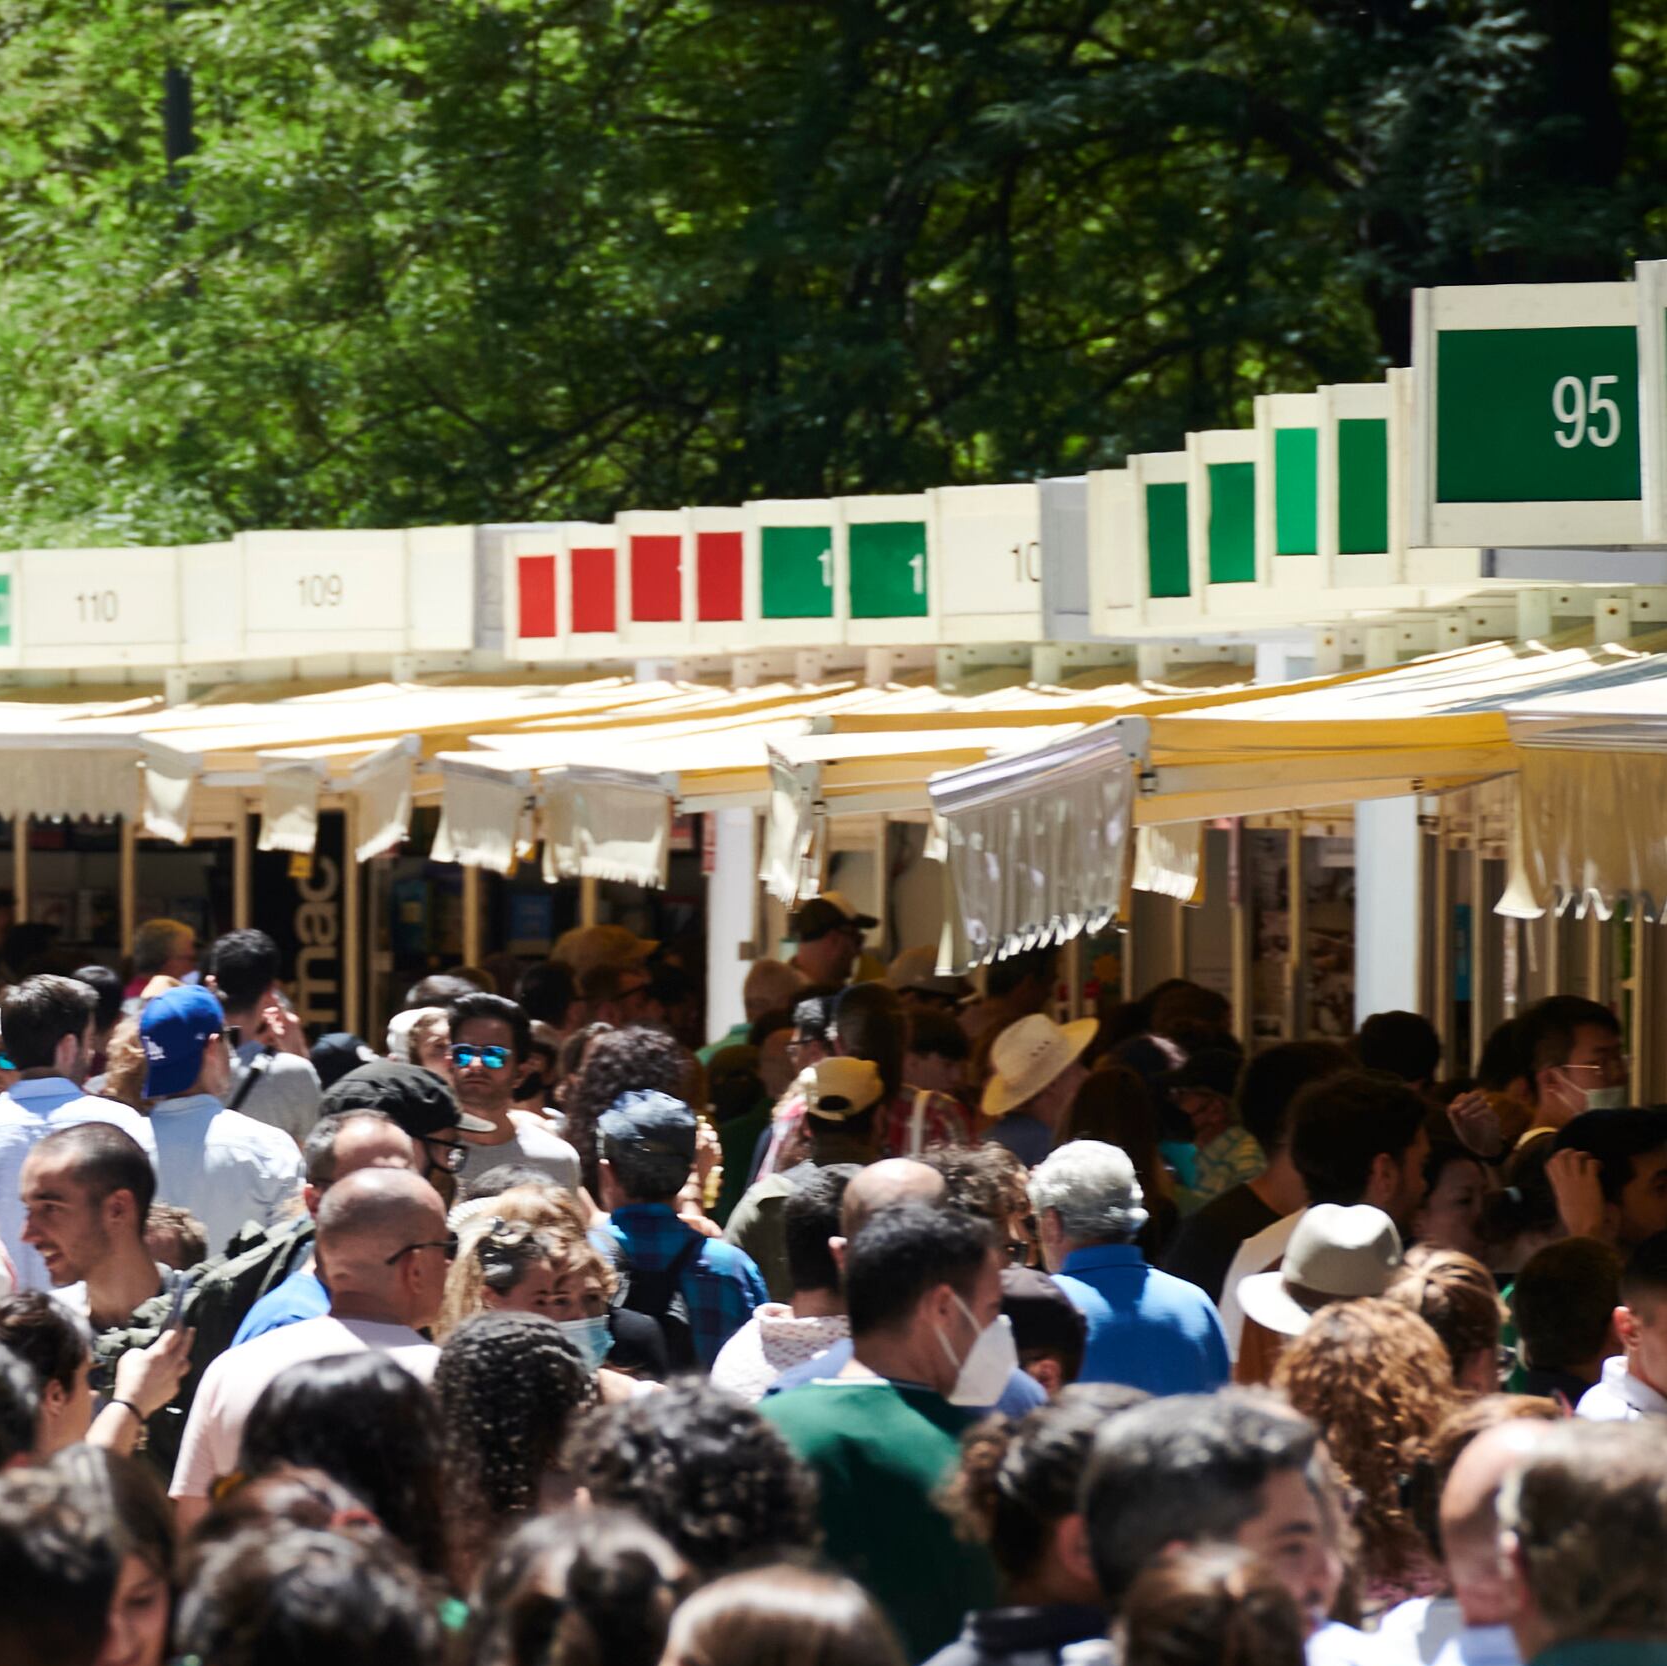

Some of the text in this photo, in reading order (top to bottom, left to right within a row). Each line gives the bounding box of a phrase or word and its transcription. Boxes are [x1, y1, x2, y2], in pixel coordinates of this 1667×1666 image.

[1552, 375, 1621, 449] 95
[75, 590, 119, 622] 110
[296, 573, 343, 608] 109
